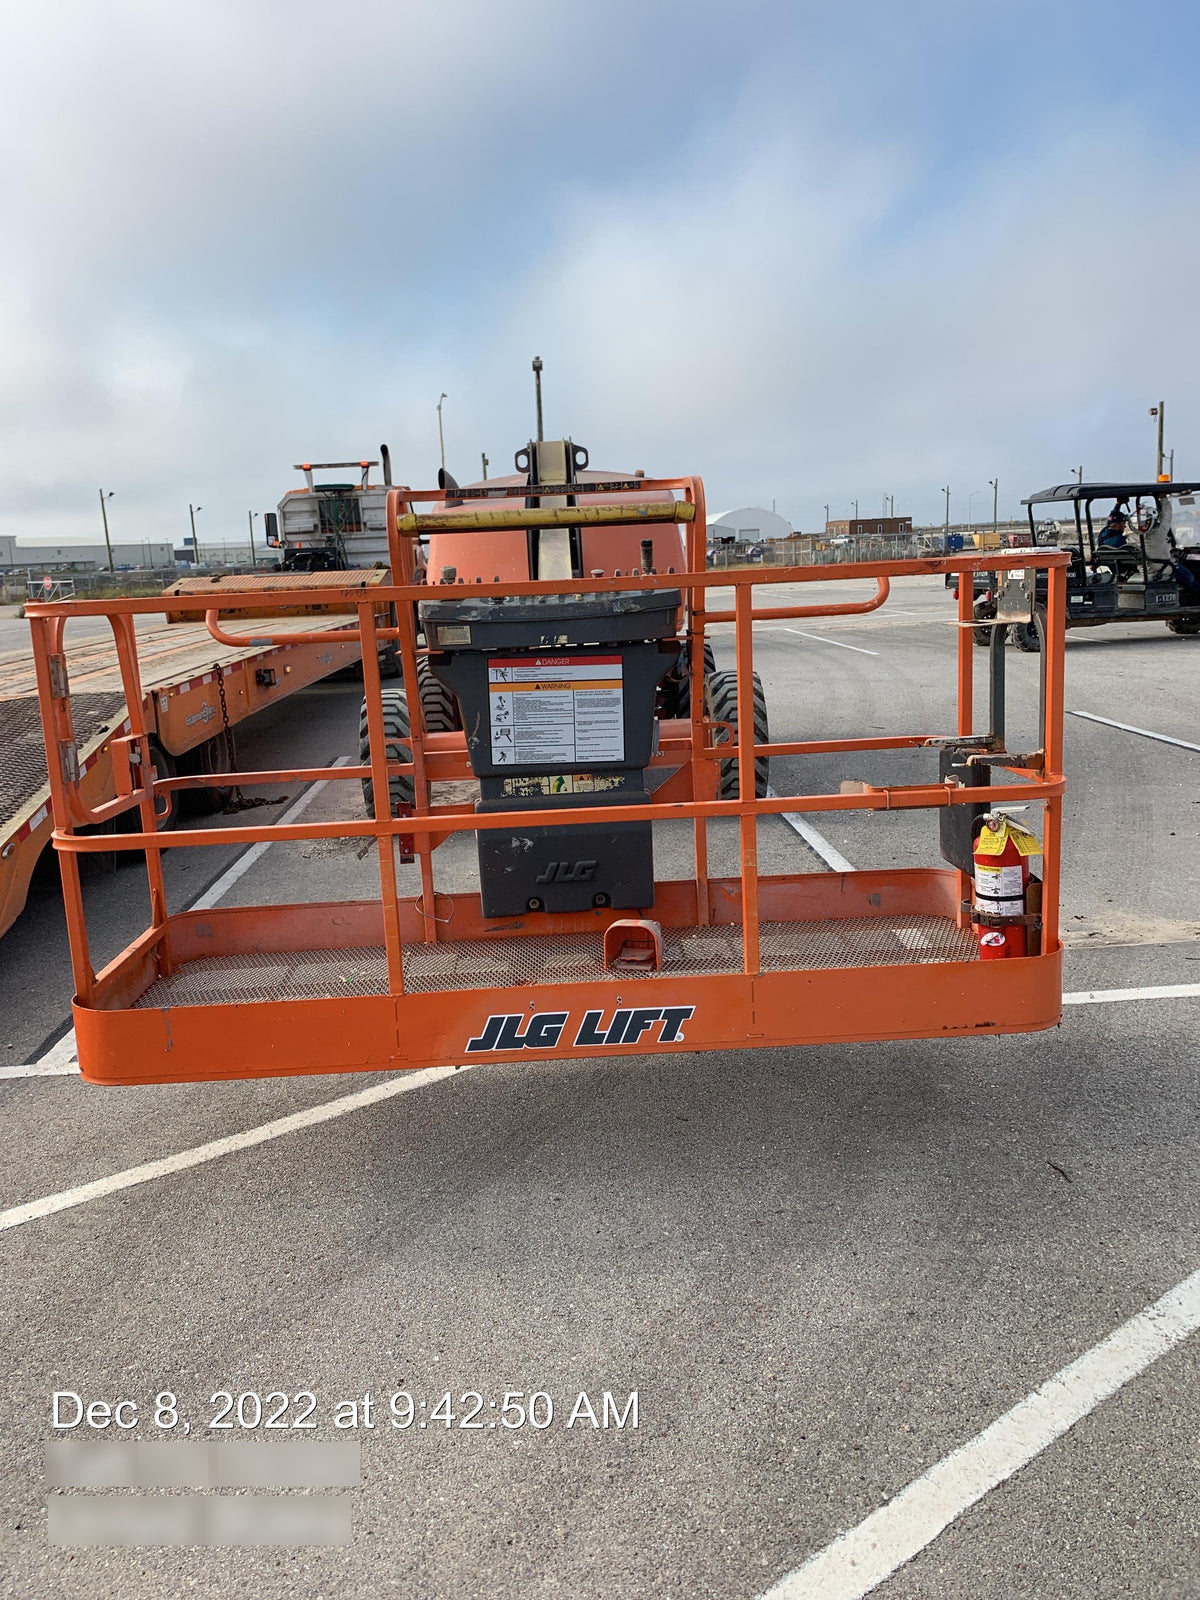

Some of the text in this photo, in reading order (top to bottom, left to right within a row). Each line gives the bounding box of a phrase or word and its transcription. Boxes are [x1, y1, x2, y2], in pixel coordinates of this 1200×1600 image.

[541, 658, 570, 666] DANGER
[541, 682, 571, 690] WARNING
[536, 860, 598, 884] JLG
[465, 1011, 570, 1052] JLG
